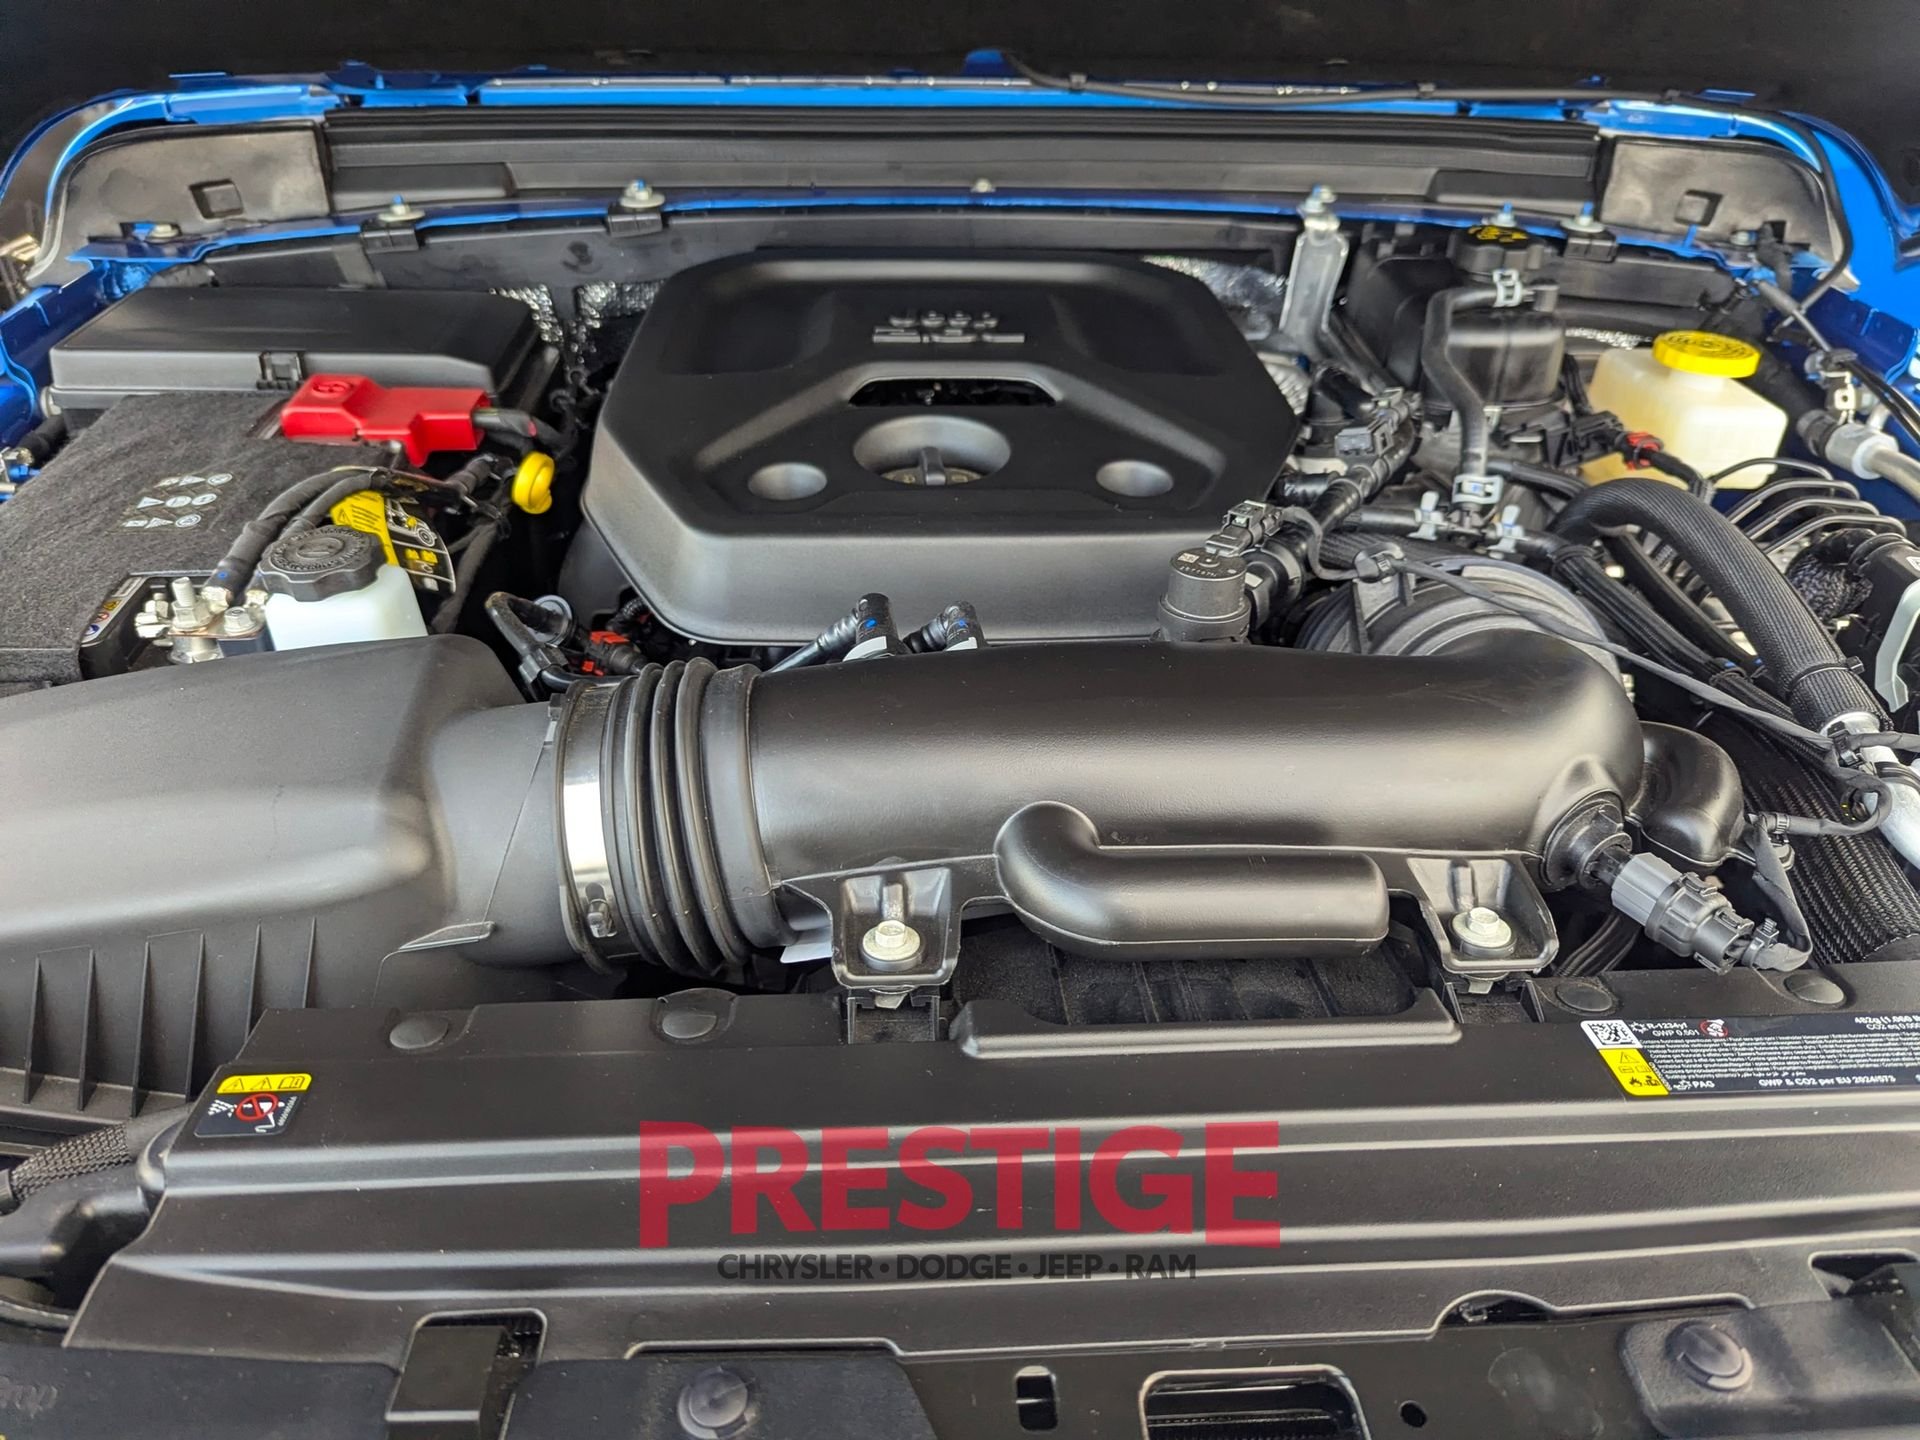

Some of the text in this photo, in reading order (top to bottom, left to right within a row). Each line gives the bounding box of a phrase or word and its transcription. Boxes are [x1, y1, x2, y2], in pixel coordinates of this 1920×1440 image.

[1652, 1029, 1674, 1037] GWP
[1691, 1080, 1715, 1089] PAG
[1758, 1078, 1783, 1087] GWP
[1795, 1077, 1818, 1086] CO2
[1818, 1077, 1835, 1087] per
[1835, 1076, 1852, 1084] EU
